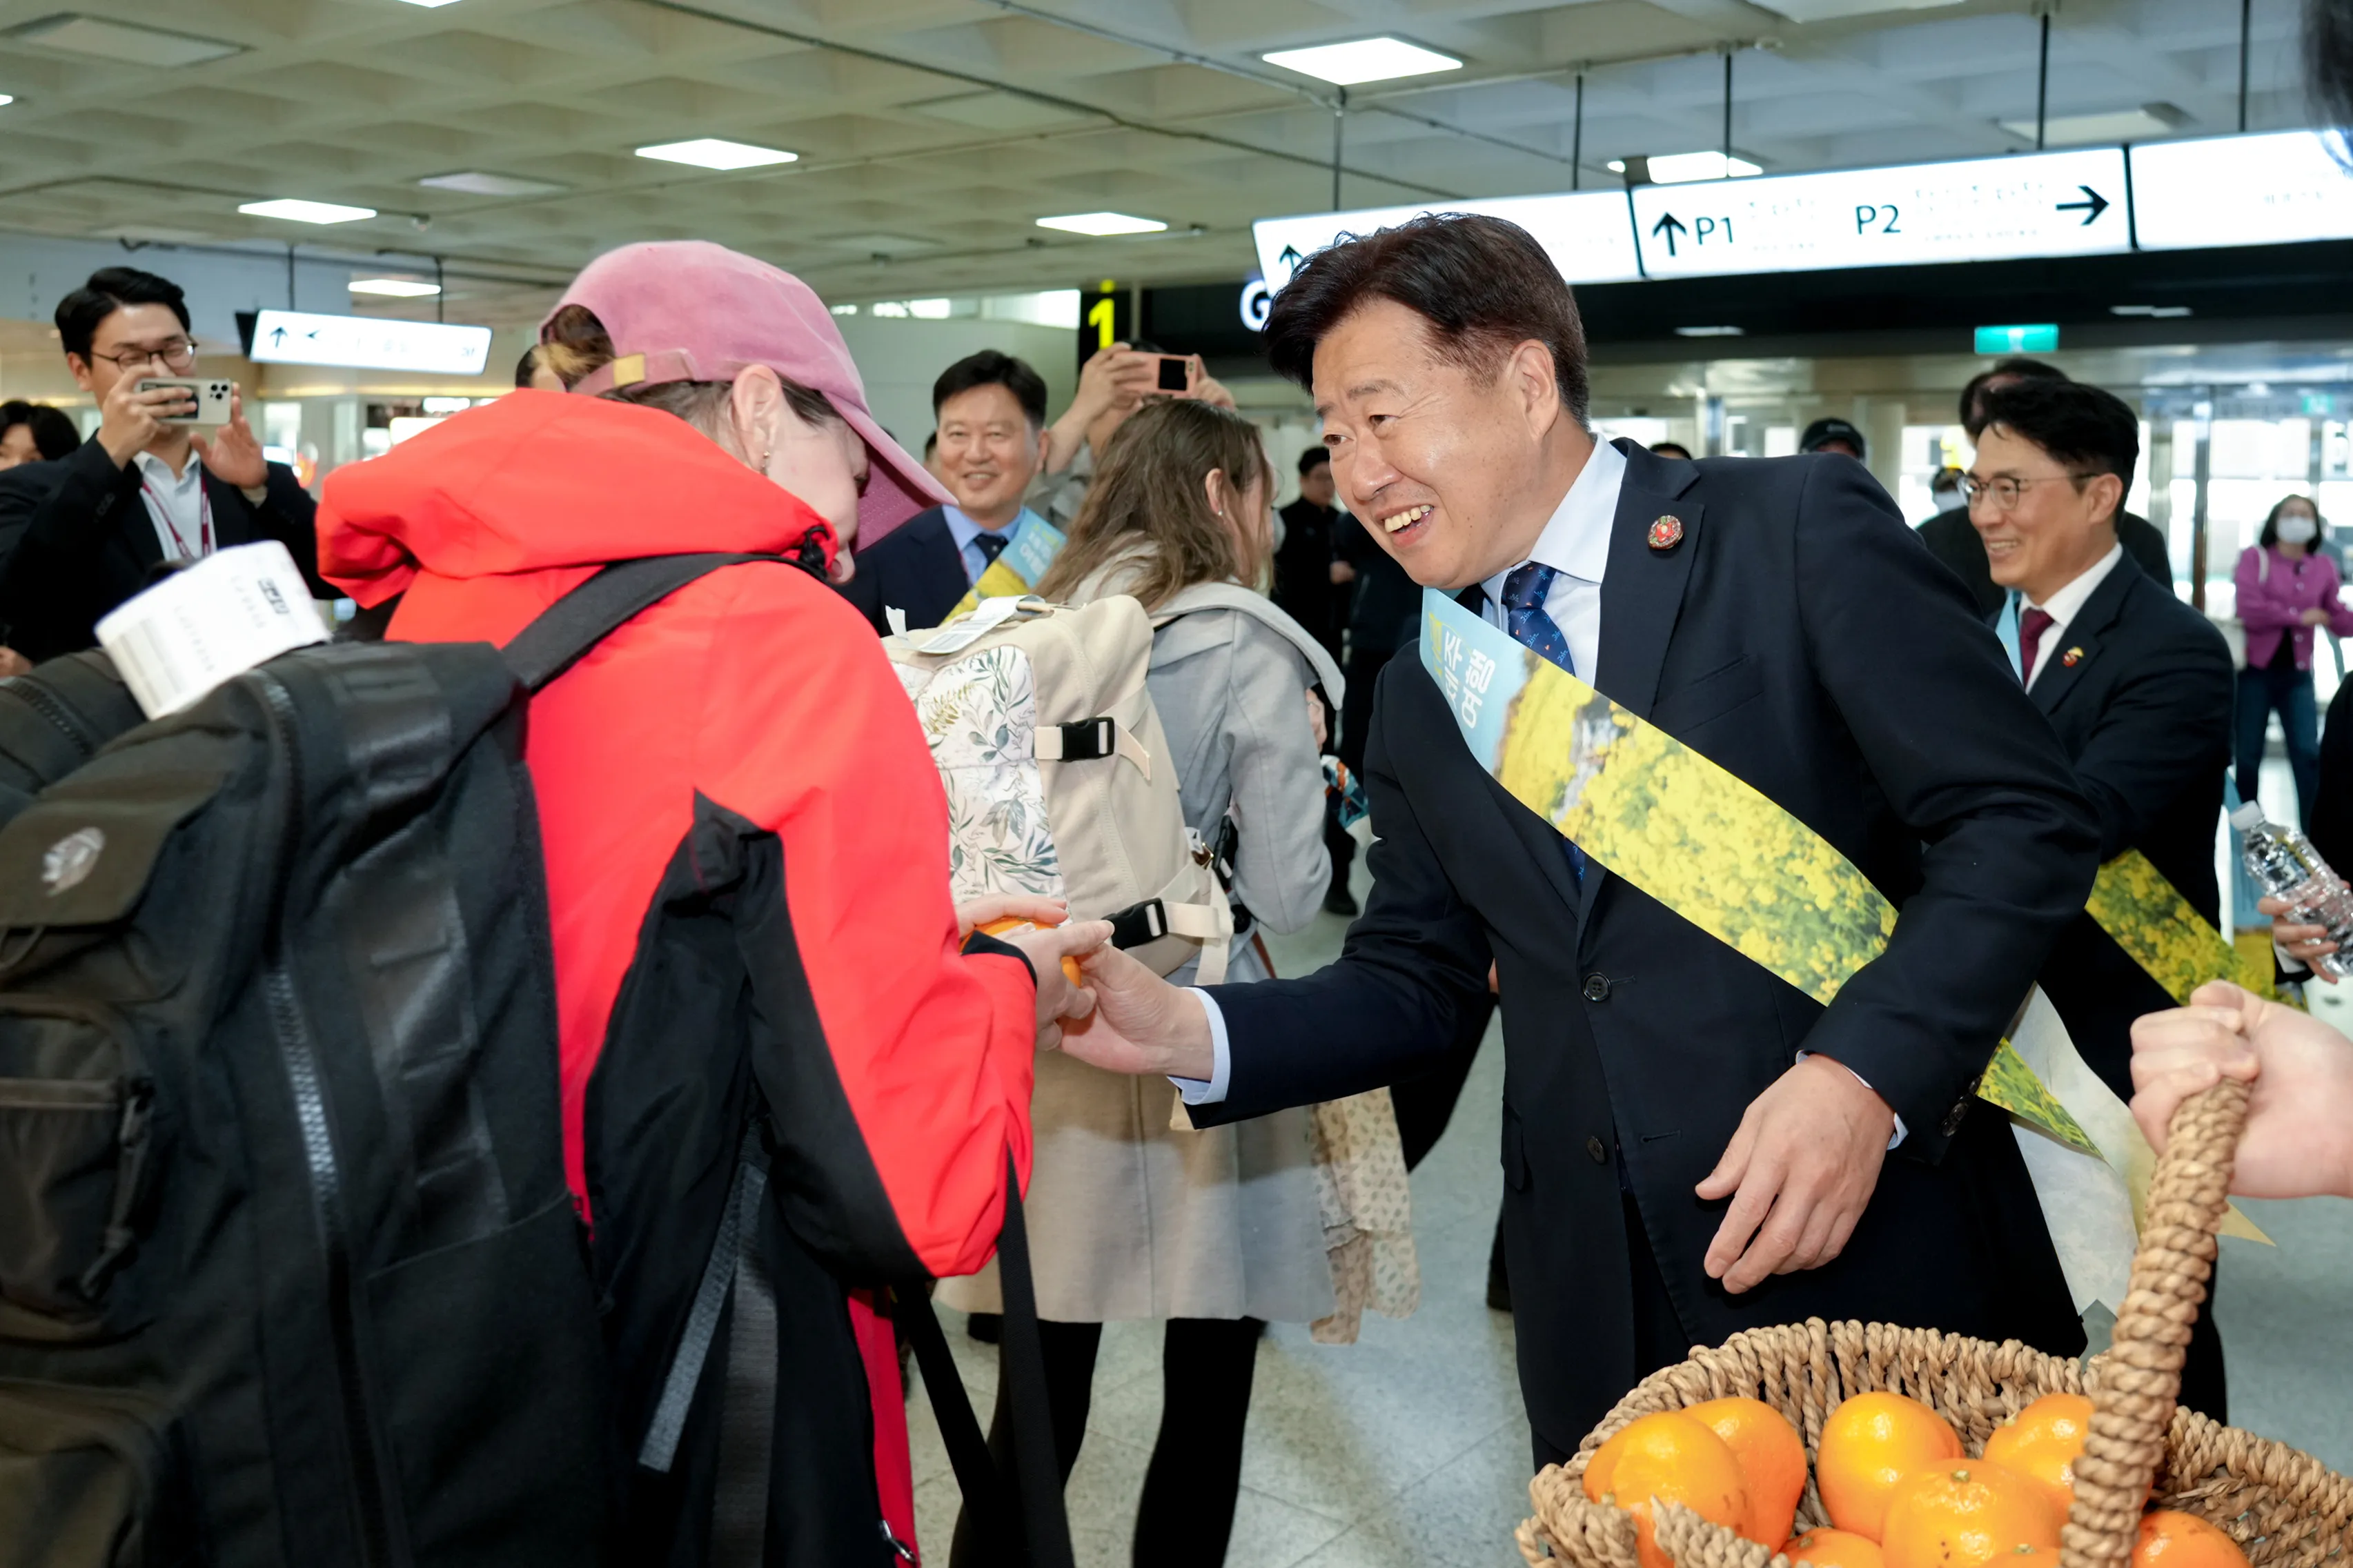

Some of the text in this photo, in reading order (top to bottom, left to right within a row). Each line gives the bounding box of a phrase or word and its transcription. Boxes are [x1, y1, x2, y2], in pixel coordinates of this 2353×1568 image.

[1695, 204, 1902, 245] P1 P2
[1088, 298, 1115, 350] 1
[1461, 648, 1496, 729] 여행
